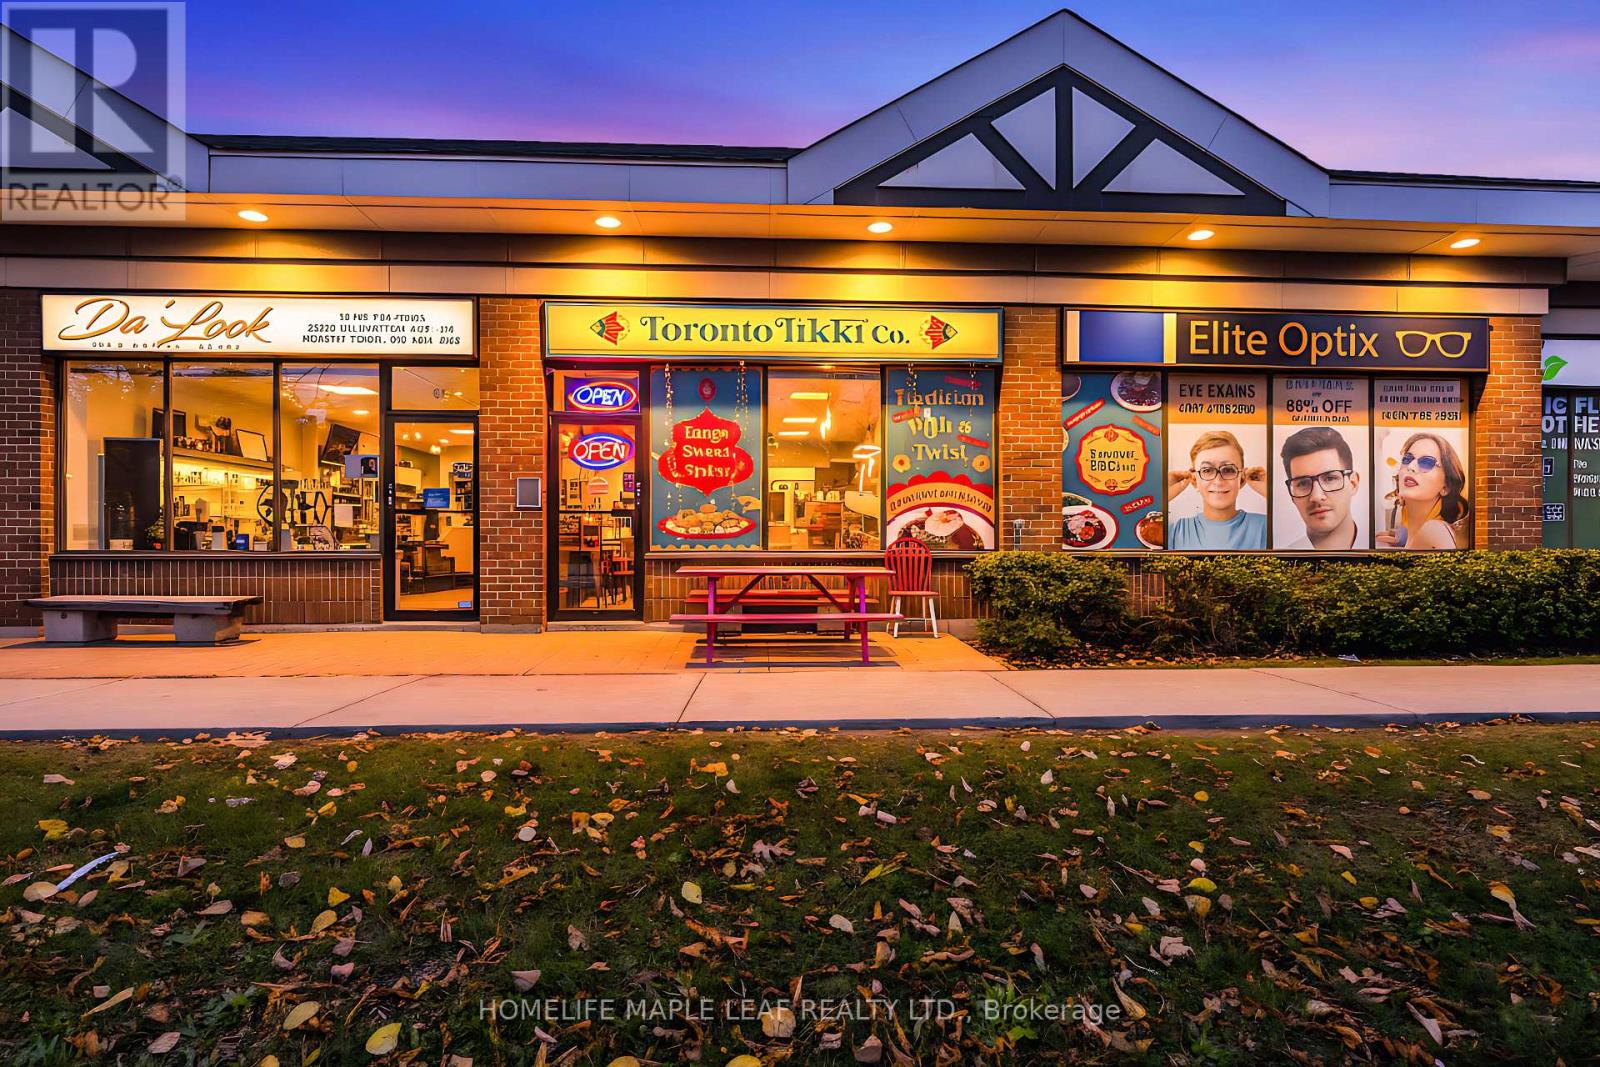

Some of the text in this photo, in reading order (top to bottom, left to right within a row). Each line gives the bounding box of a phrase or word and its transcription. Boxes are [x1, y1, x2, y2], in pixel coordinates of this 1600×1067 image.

[639, 316, 773, 342] Toronto
[871, 324, 911, 344] Co.
[1189, 320, 1380, 366] Elite Optix
[576, 387, 626, 407] OPEN
[1179, 383, 1203, 398] EYE
[1322, 399, 1353, 414] OFF
[573, 442, 626, 461] OPEN
